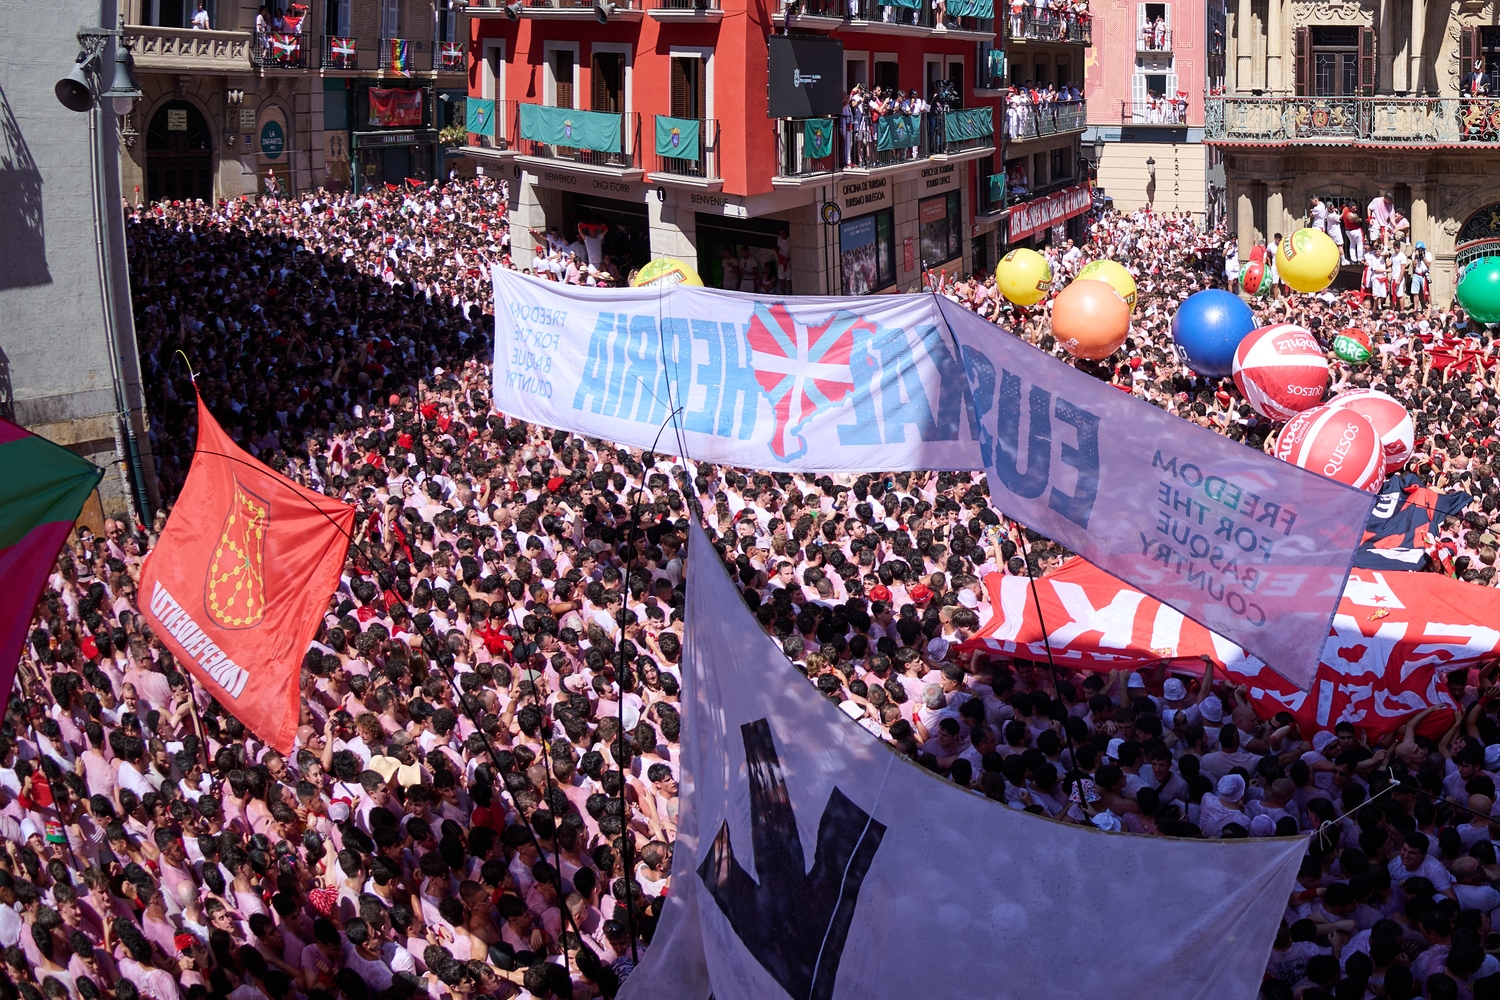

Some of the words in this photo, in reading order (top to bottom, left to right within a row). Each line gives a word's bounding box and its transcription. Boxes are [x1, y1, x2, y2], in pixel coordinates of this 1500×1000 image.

[268, 130, 276, 138] LA
[262, 137, 283, 146] INFANTIL
[480, 161, 505, 173] WELCOME
[544, 172, 577, 186] BIENVENIDO
[592, 179, 609, 190] ONGI
[609, 181, 630, 193] ETORRI
[842, 183, 861, 195] OFICINA
[861, 182, 868, 191] DE
[868, 178, 886, 190] TURISMO
[691, 193, 728, 207] BIENVENUE
[845, 195, 864, 208] TURISMO
[1287, 384, 1323, 396] QUESOS
[1323, 423, 1359, 476] QUESOS
